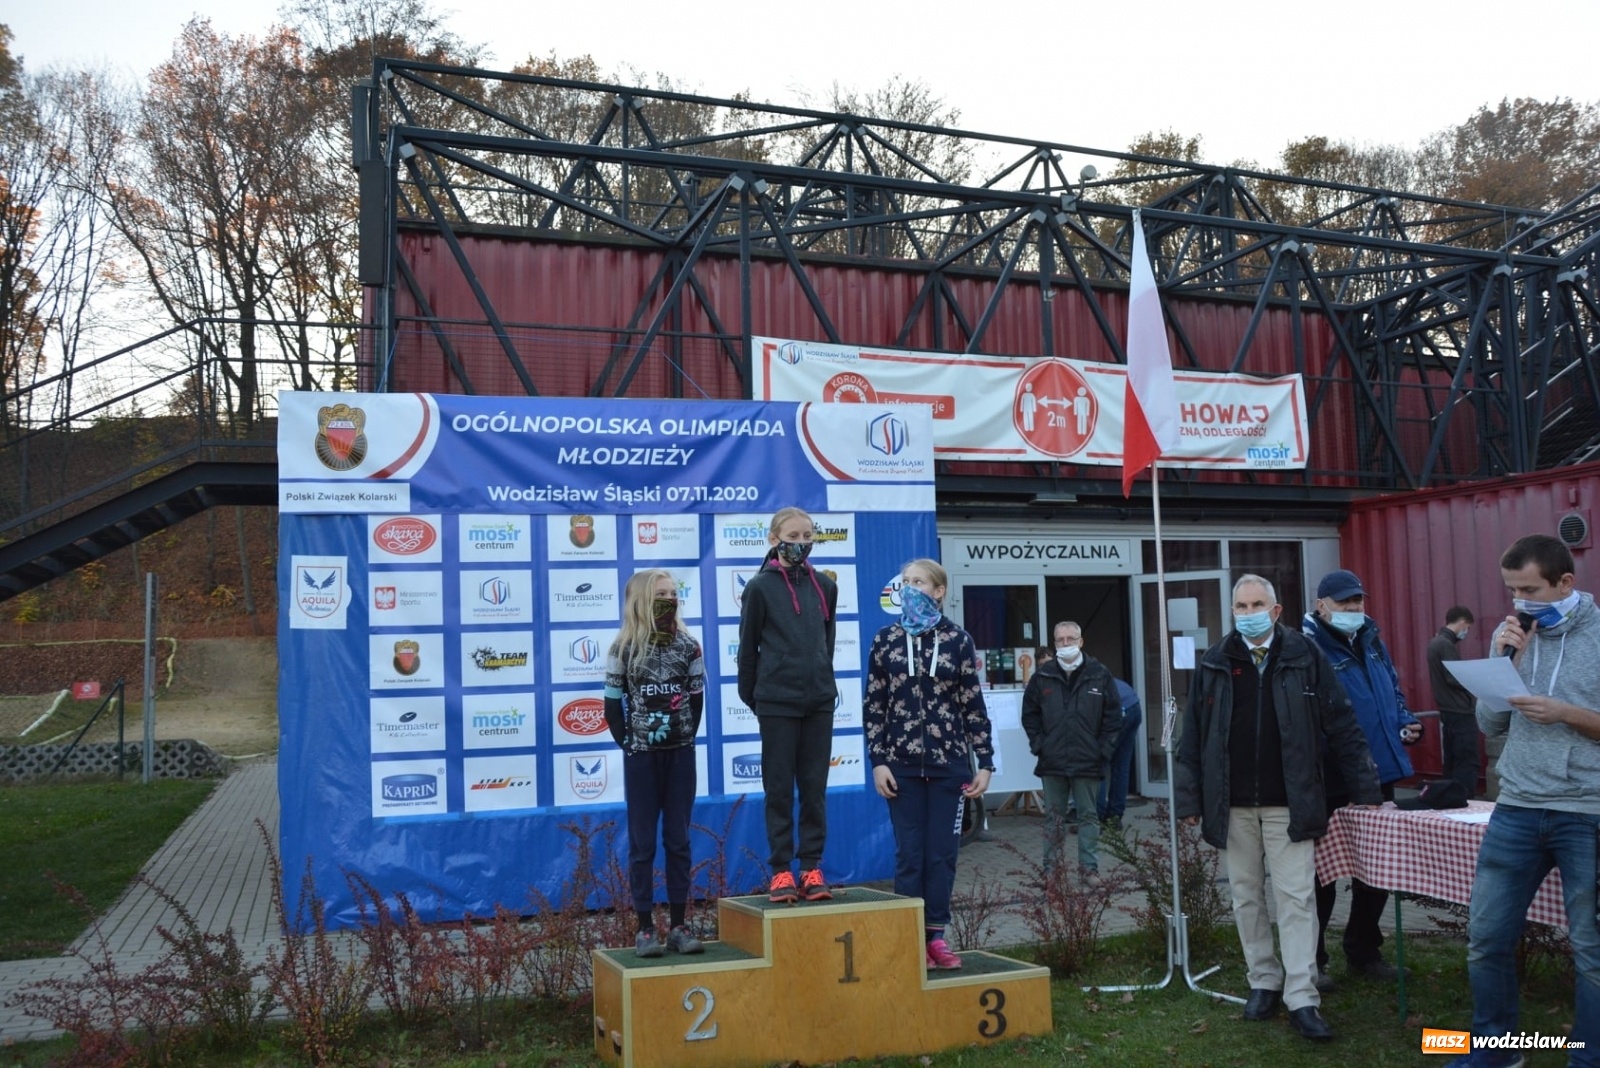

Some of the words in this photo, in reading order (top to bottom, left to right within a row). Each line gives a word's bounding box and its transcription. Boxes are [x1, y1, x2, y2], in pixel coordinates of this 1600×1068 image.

[831, 374, 869, 393] KORONA
[1047, 411, 1066, 428] 2m
[1180, 403, 1269, 424] HOWAJ
[452, 411, 653, 435] OGÓLNOPOLSKA
[660, 419, 785, 437] OLIMPIADA
[1179, 427, 1201, 438] ZNĄ
[557, 444, 695, 466] MŁODZIEŻY
[1247, 444, 1290, 459] mosir
[857, 459, 899, 467] WODZISŁAW
[901, 458, 924, 468] ŚLĄSKI
[1254, 459, 1286, 468] centrum
[286, 492, 315, 501] Polski
[318, 492, 356, 503] Związek
[358, 493, 397, 501] Kolarski
[487, 484, 599, 502] Wodzisław
[604, 483, 661, 506] Śląski
[666, 486, 759, 502] 07.11.2020
[381, 526, 424, 540] skawa
[468, 525, 521, 541] mosir
[723, 524, 769, 539] mosir
[475, 541, 515, 550] centrum
[729, 538, 764, 546] centrum
[966, 541, 1120, 559] WYPOŻYCZALNIA
[301, 596, 336, 605] AQUILA
[554, 592, 613, 601] Timemaster
[500, 652, 528, 660] TEAM
[640, 683, 681, 696] FENIKS
[472, 711, 526, 728] mosir
[376, 722, 440, 732] Timemaster
[479, 727, 519, 736] centrum
[734, 763, 762, 776] KAP
[384, 782, 435, 798] KAPRIN
[575, 781, 603, 789] AQUILA
[834, 930, 861, 984] 1
[682, 985, 719, 1042] 2
[978, 988, 1006, 1039] 3
